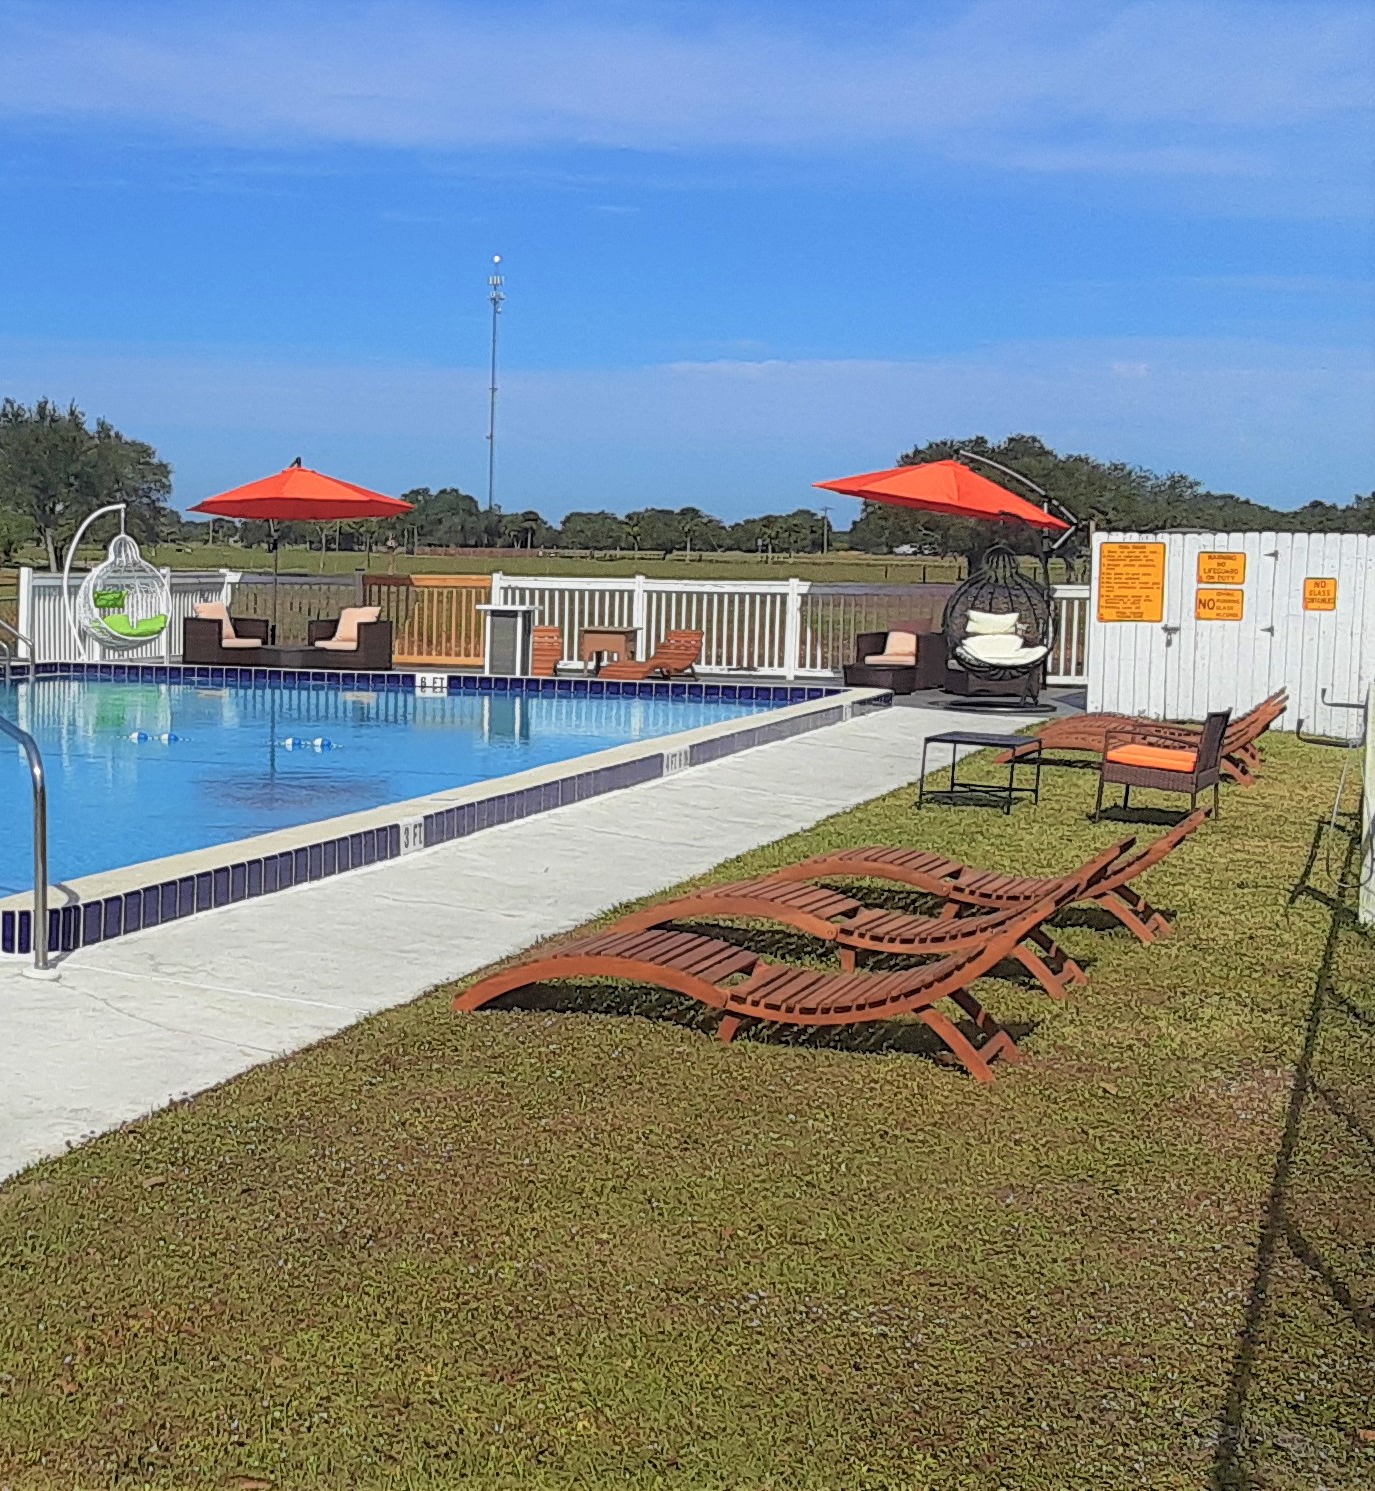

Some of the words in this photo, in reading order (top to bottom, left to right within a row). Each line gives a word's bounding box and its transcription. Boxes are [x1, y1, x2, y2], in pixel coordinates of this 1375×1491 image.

[1198, 598, 1215, 610] NO
[404, 826, 409, 848] 3
[413, 823, 422, 846] FT
